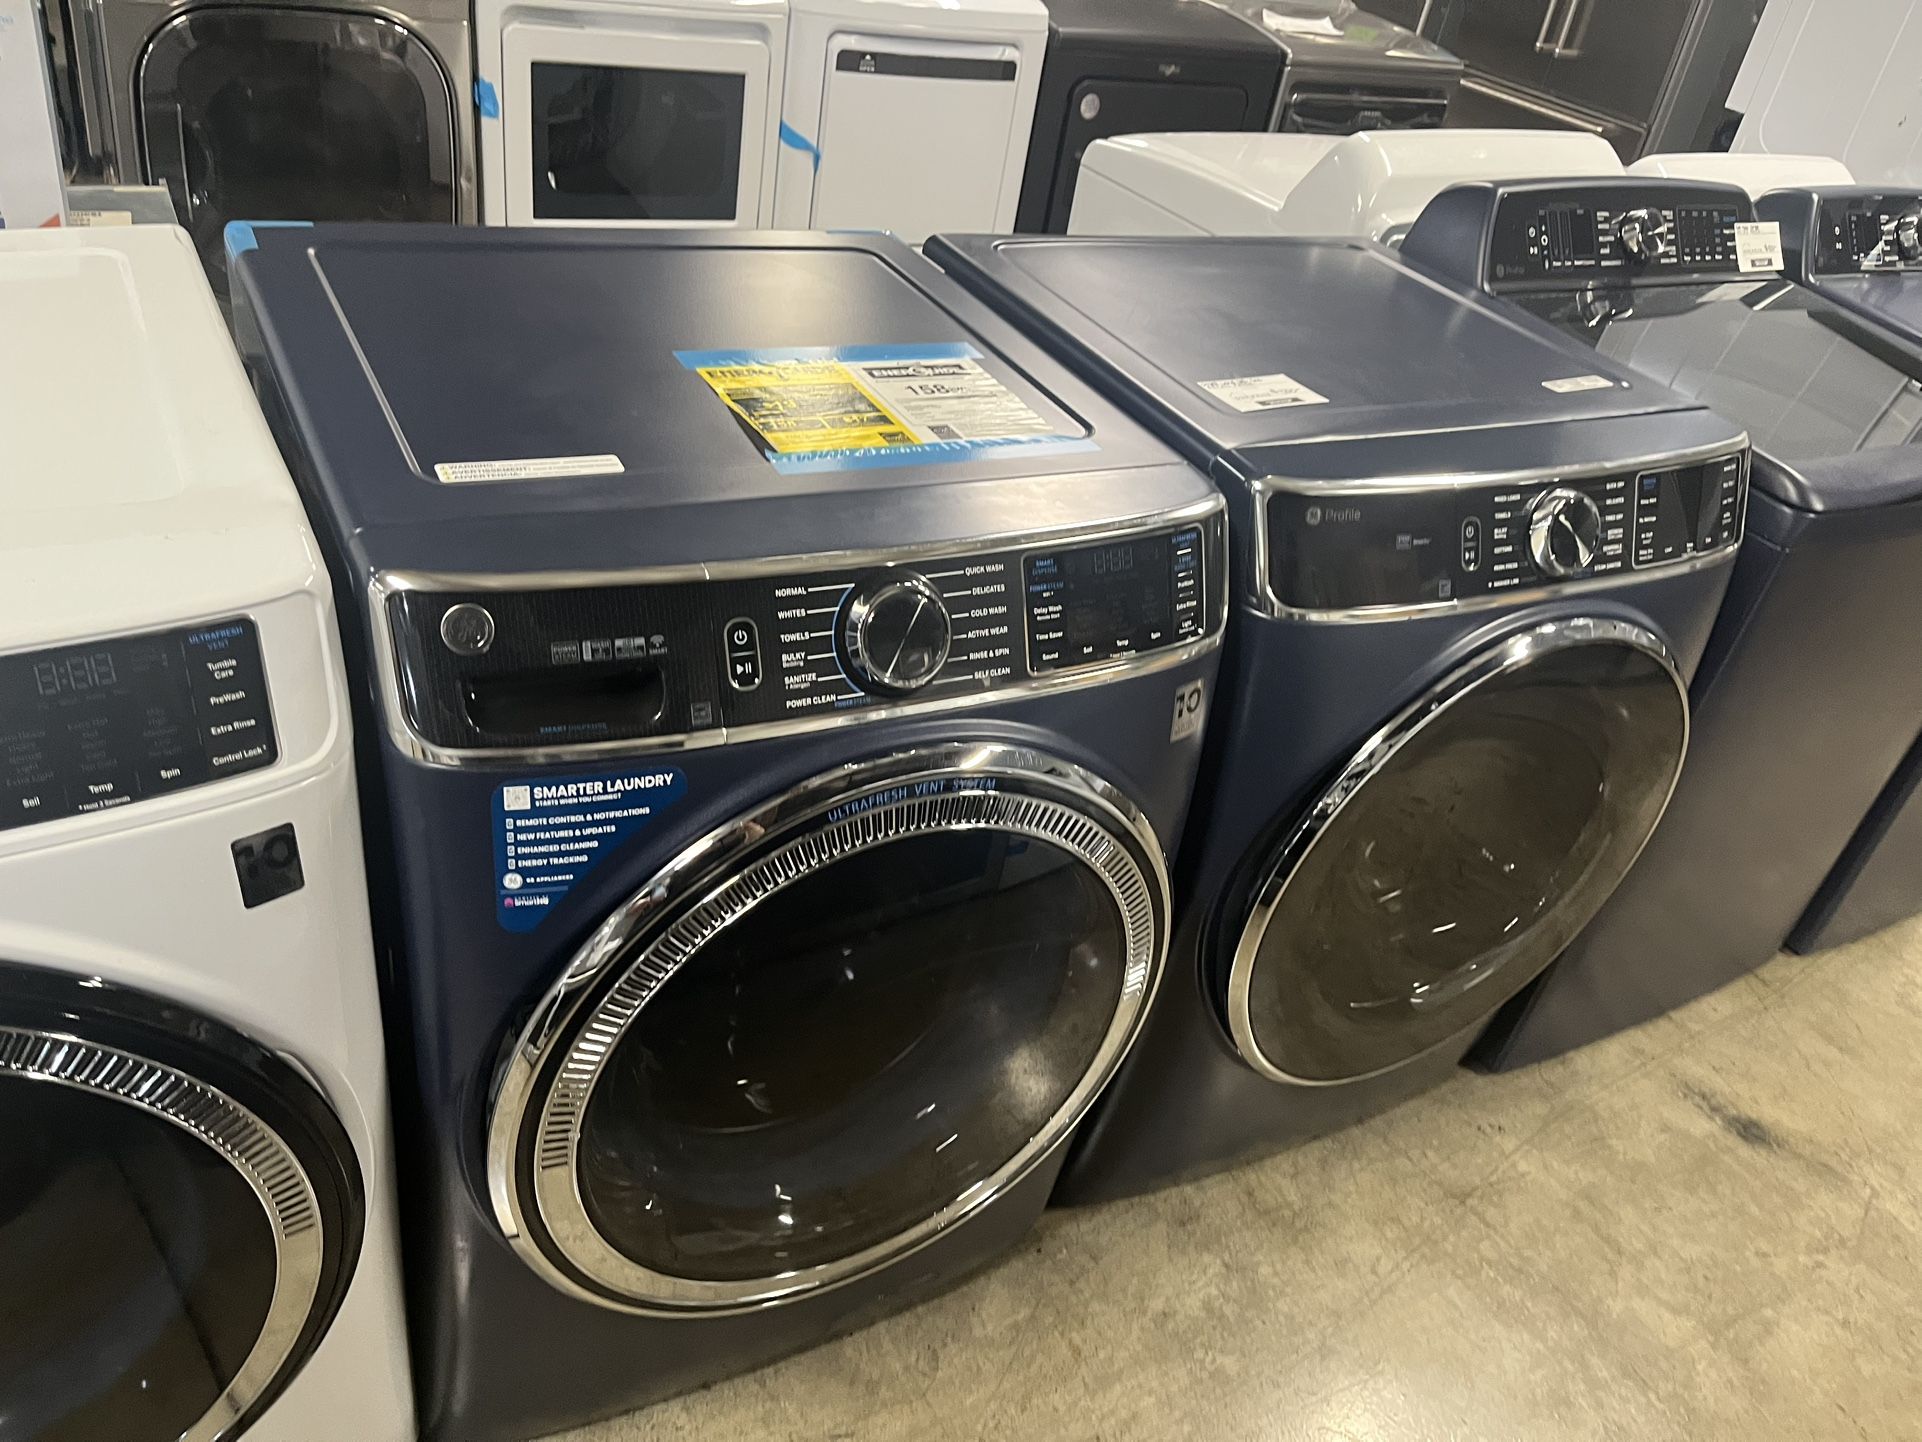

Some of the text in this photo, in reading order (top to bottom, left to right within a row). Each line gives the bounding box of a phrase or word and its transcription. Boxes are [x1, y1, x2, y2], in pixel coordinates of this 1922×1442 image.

[905, 384, 950, 396] 158
[1325, 508, 1361, 521] Profile
[965, 564, 1004, 577] QUICK WASH
[775, 587, 807, 597] NORMAL
[972, 584, 1005, 596] DELICATES
[778, 608, 806, 620] WHITES
[971, 606, 1007, 618] COLD WASH
[188, 627, 243, 644] ULTRAFRESH
[780, 632, 810, 643] TOWELS
[968, 626, 1008, 639] ACTIVE WEAR
[207, 641, 229, 651] VENT
[782, 652, 805, 662] BULKY
[969, 650, 988, 661] RINSE
[995, 647, 1010, 657] SPIN
[1042, 652, 1059, 661] Sound
[206, 658, 237, 672] Tumble
[214, 668, 234, 680] Care
[784, 673, 817, 685] SANITIZE
[974, 667, 1011, 680] SELF CLEAN
[210, 690, 246, 706] PreWash
[786, 693, 836, 710] POWER CLEAN
[210, 718, 256, 736] Extra Rinse
[212, 746, 263, 767] Control Lock
[160, 768, 181, 780] Spin
[88, 782, 113, 796] Temp
[533, 772, 674, 799] SMARTER LAUNDRY
[22, 796, 40, 809] Soil
[535, 799, 558, 808] STARTS
[559, 797, 578, 805] WHEN
[827, 778, 997, 823] ULTRAFRESH VENT SYSTEM
[516, 807, 650, 828] REMOTE CONTROL & NOTIFICATIONS
[517, 825, 616, 842] NEW FEATURES & UPDATES
[517, 840, 599, 855] ENHANCED CLEANING
[517, 854, 589, 868] ENERGY TRACKING
